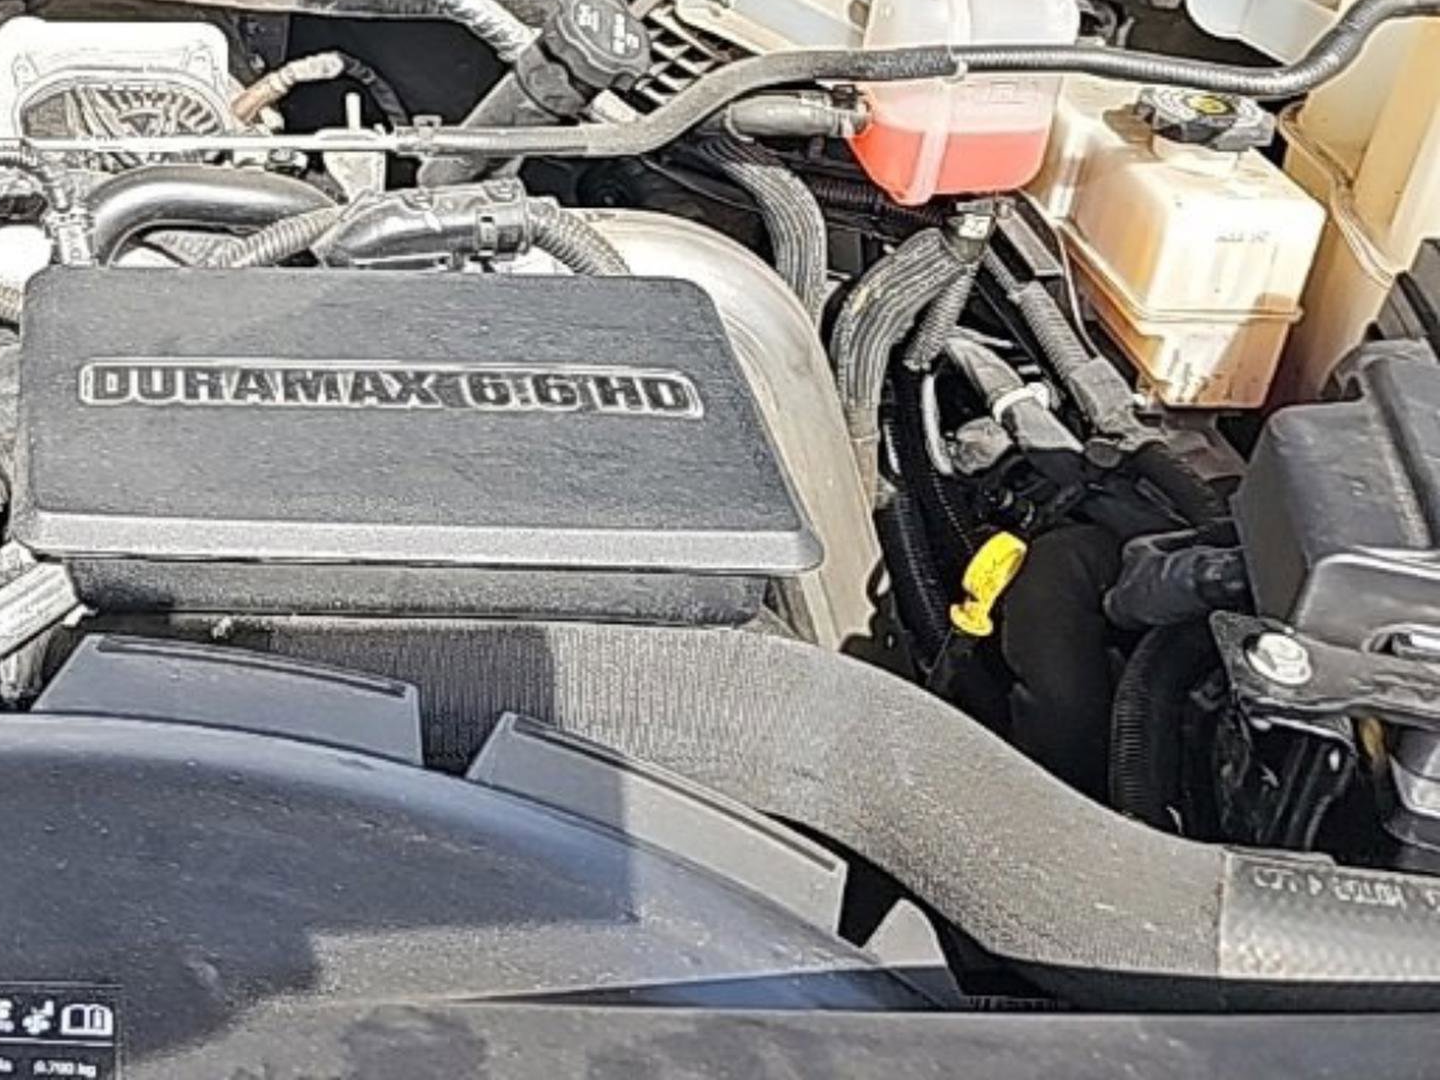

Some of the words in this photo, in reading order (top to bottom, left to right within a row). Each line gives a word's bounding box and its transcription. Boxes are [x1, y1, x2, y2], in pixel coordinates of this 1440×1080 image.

[90, 365, 444, 407] DURAMAX
[466, 371, 580, 408] 6.6
[591, 373, 693, 411] HD
